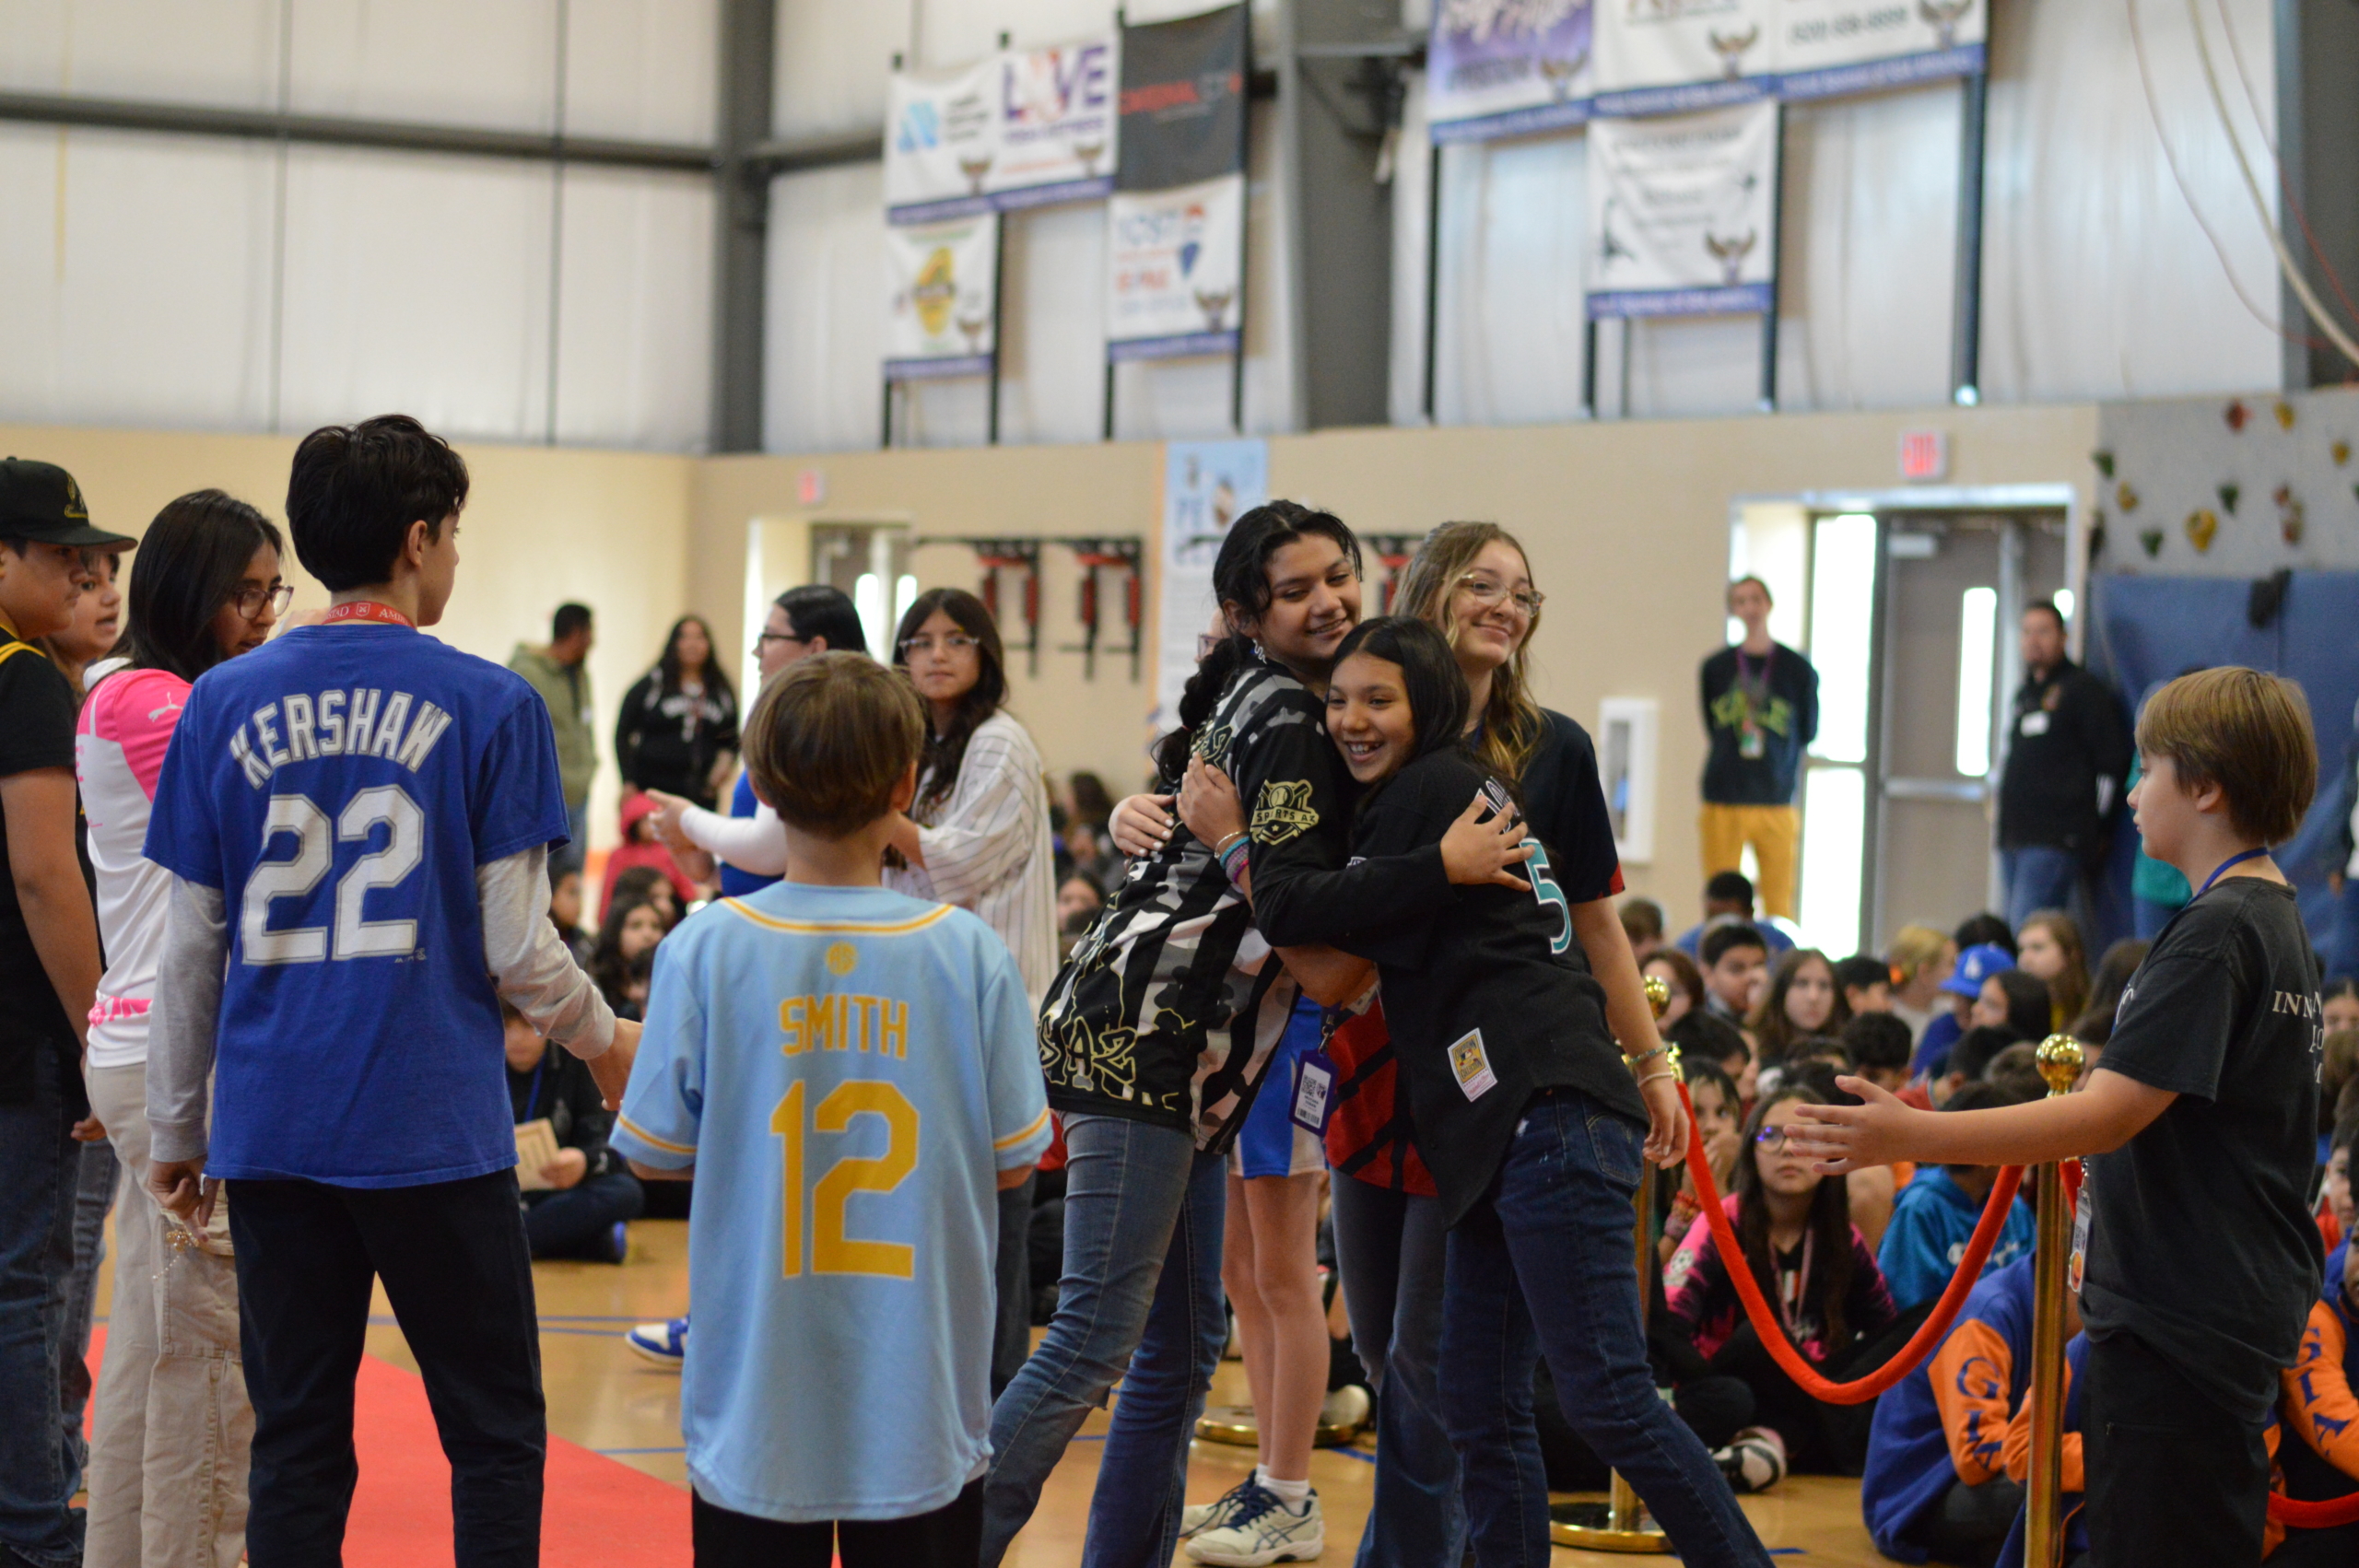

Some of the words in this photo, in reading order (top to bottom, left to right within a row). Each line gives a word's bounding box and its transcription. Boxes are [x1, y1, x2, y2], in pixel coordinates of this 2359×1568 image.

[229, 688, 452, 790] KERSHAW
[1257, 808, 1296, 823] SPRTS
[241, 783, 425, 966] 22
[778, 993, 910, 1061] SMITH
[769, 1078, 921, 1281] 12
